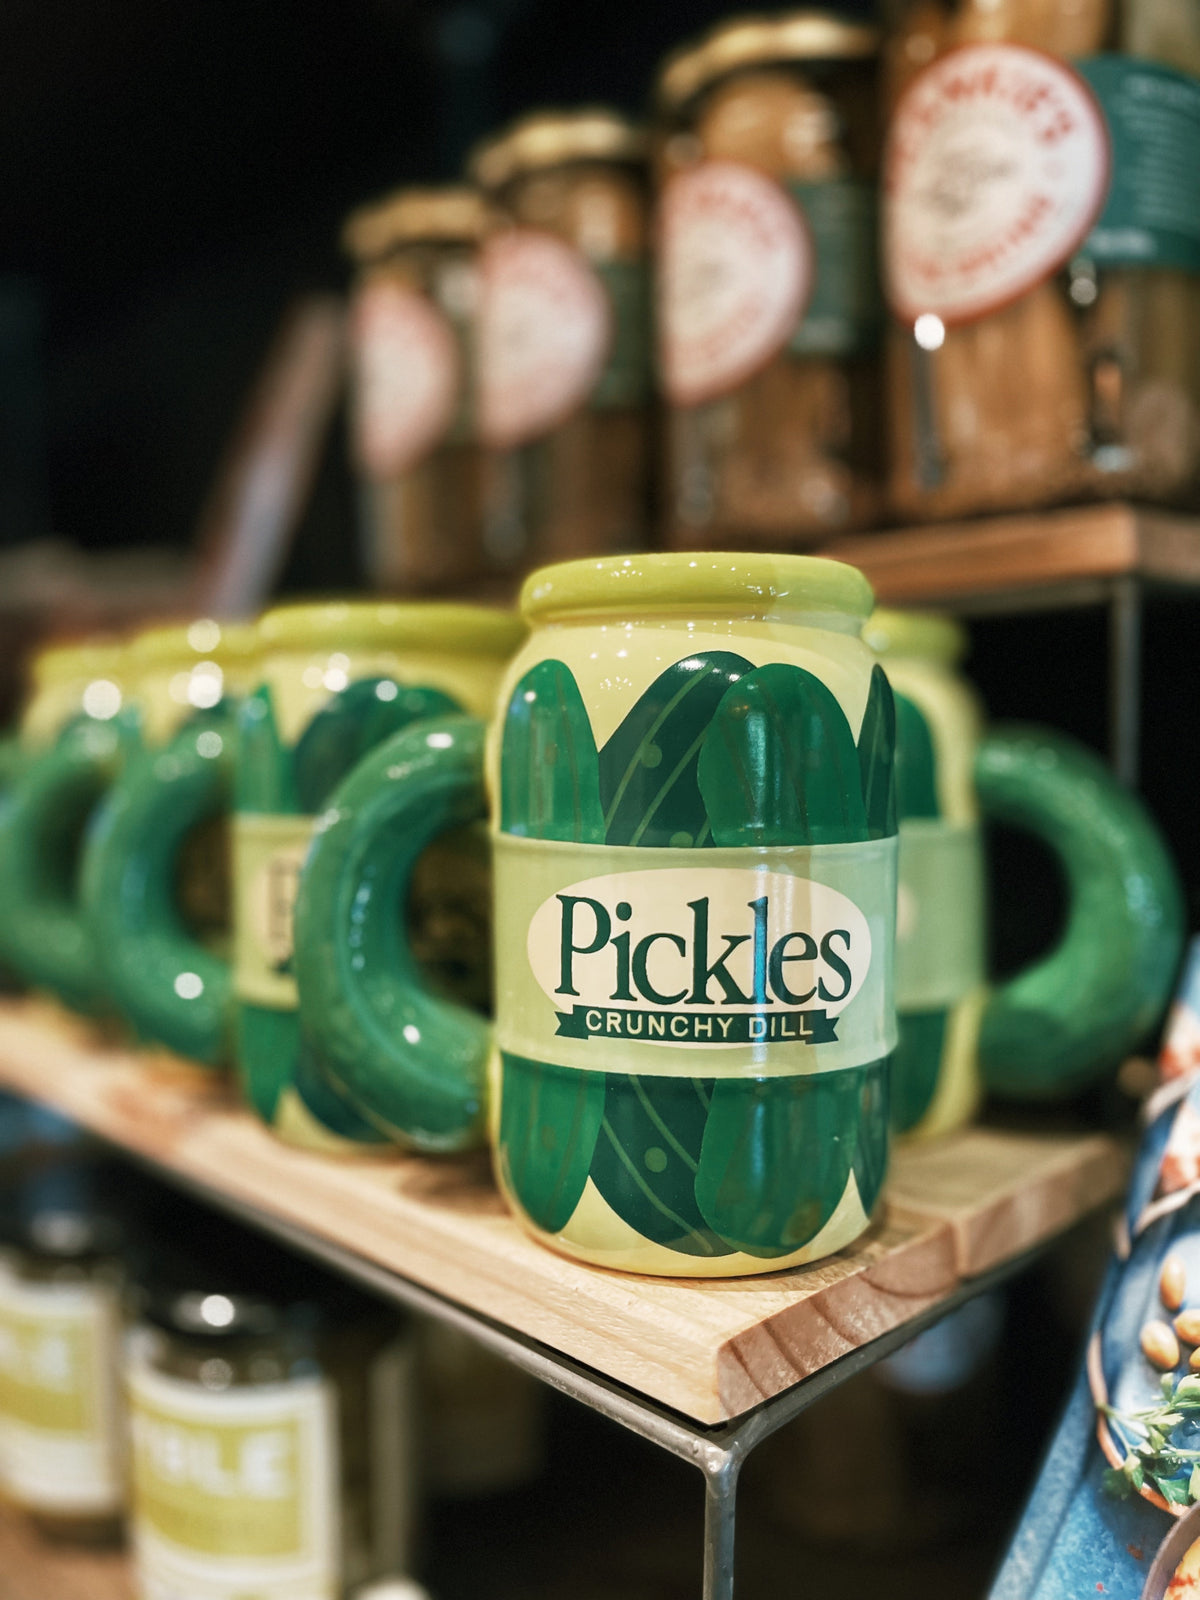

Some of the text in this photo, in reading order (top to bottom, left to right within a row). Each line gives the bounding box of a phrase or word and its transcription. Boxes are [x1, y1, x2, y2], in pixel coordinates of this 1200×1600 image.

[554, 894, 853, 1005] Pickles
[585, 1009, 814, 1039] CRUNCHY DILL
